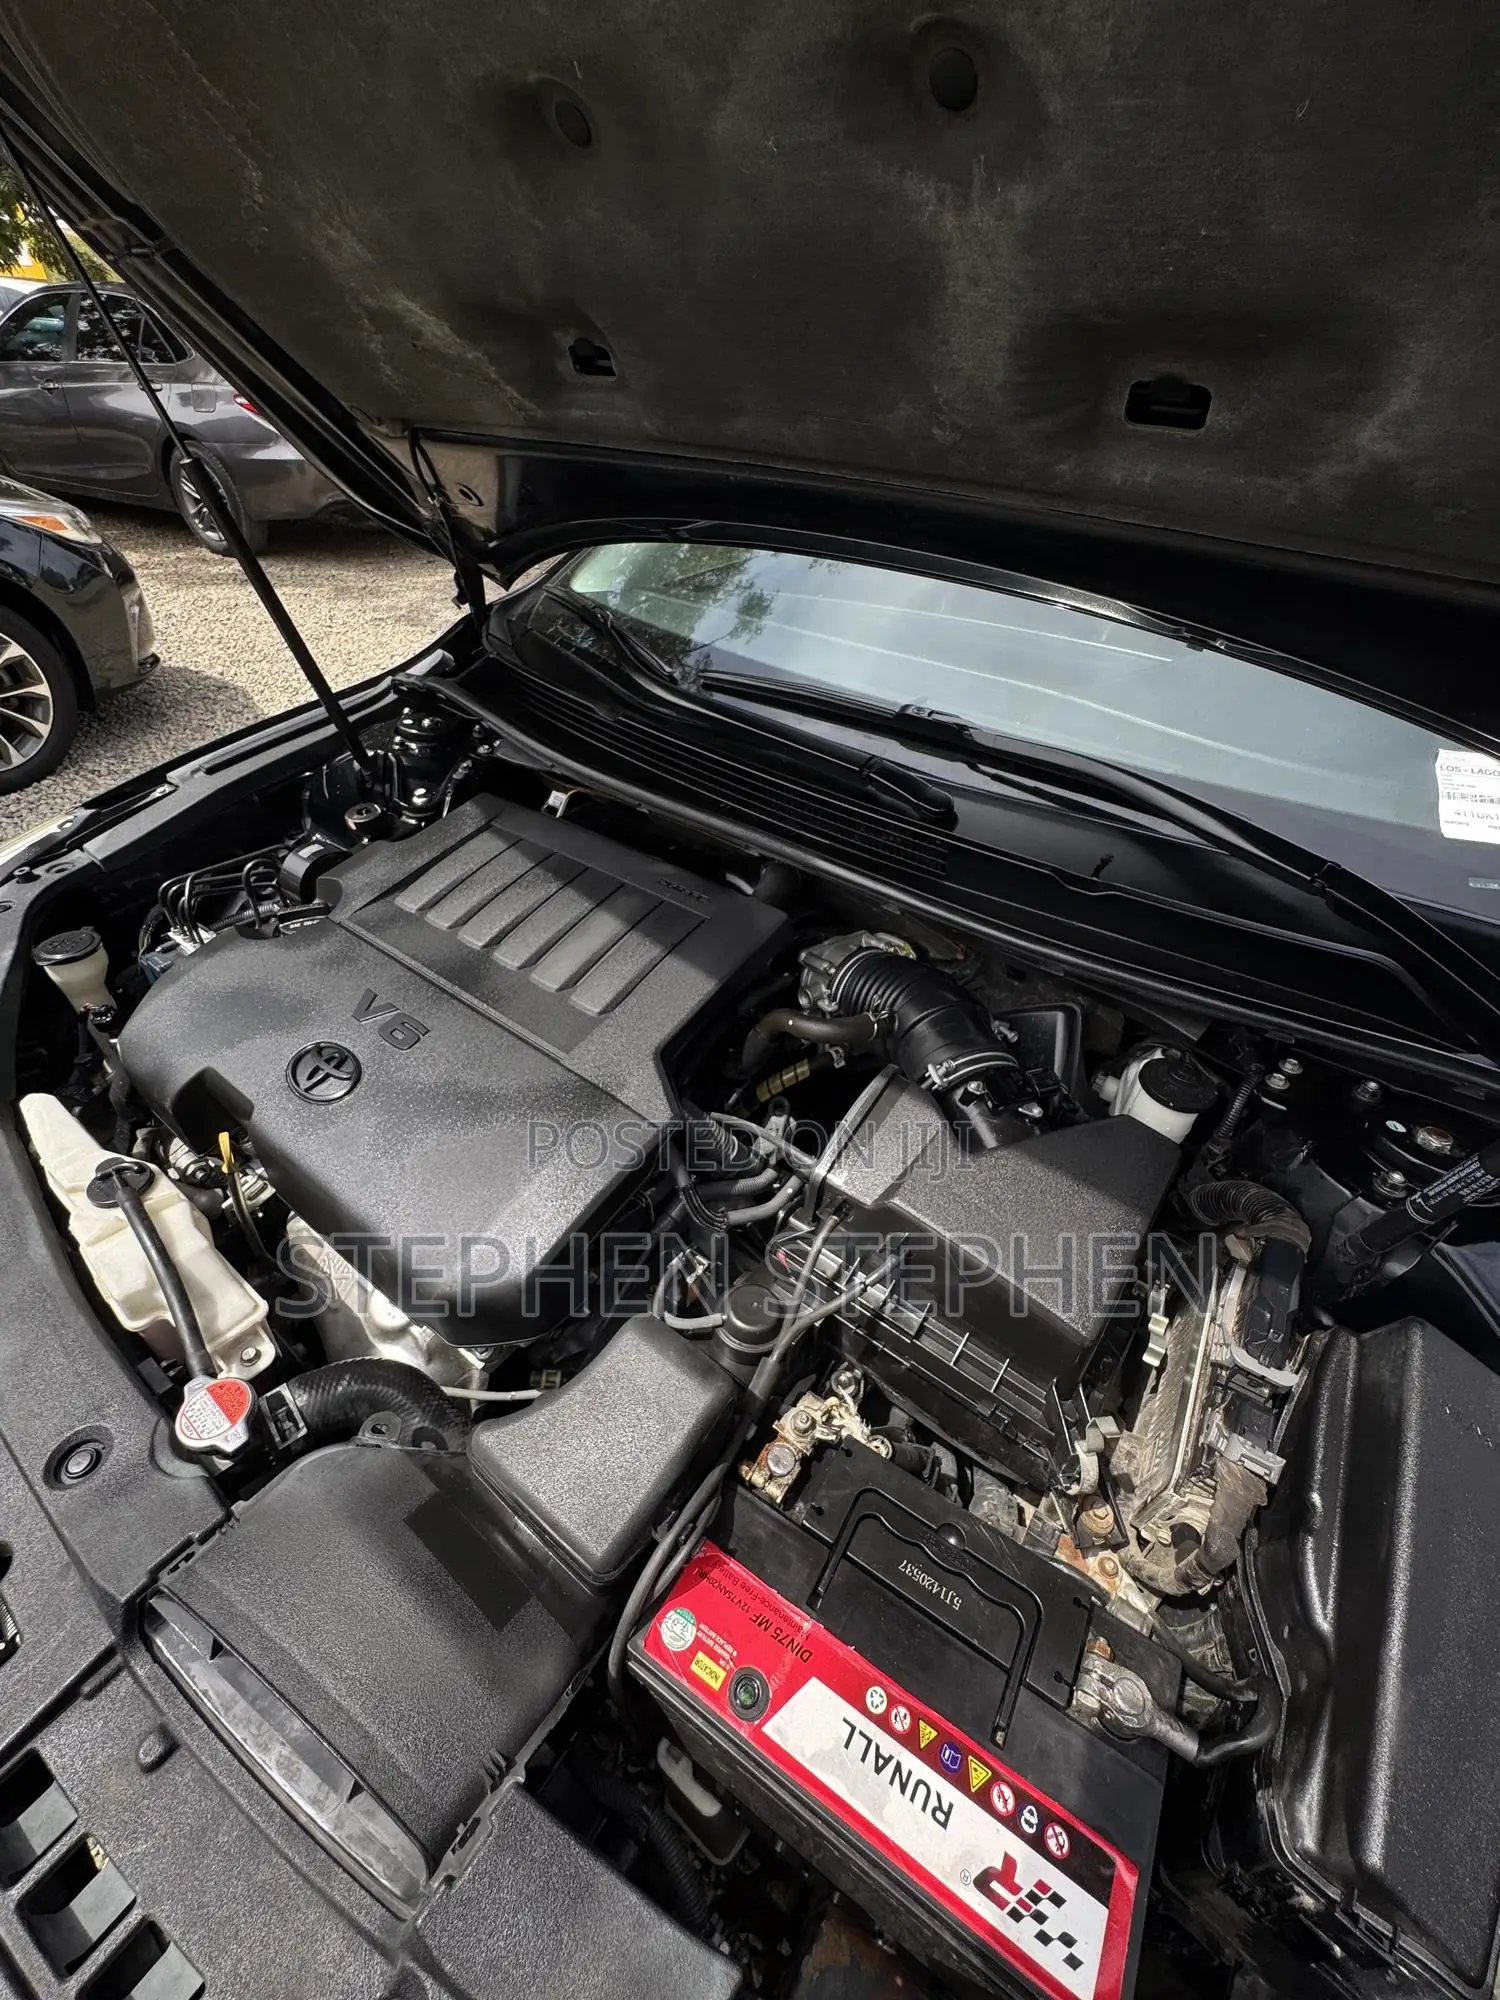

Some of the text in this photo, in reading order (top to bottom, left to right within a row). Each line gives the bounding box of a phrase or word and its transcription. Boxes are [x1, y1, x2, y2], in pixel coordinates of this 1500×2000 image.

[352, 988, 430, 1050] V6
[749, 1612, 774, 1632] MF
[769, 1626, 813, 1664] DIN75
[842, 1716, 953, 1831] RUNALL
